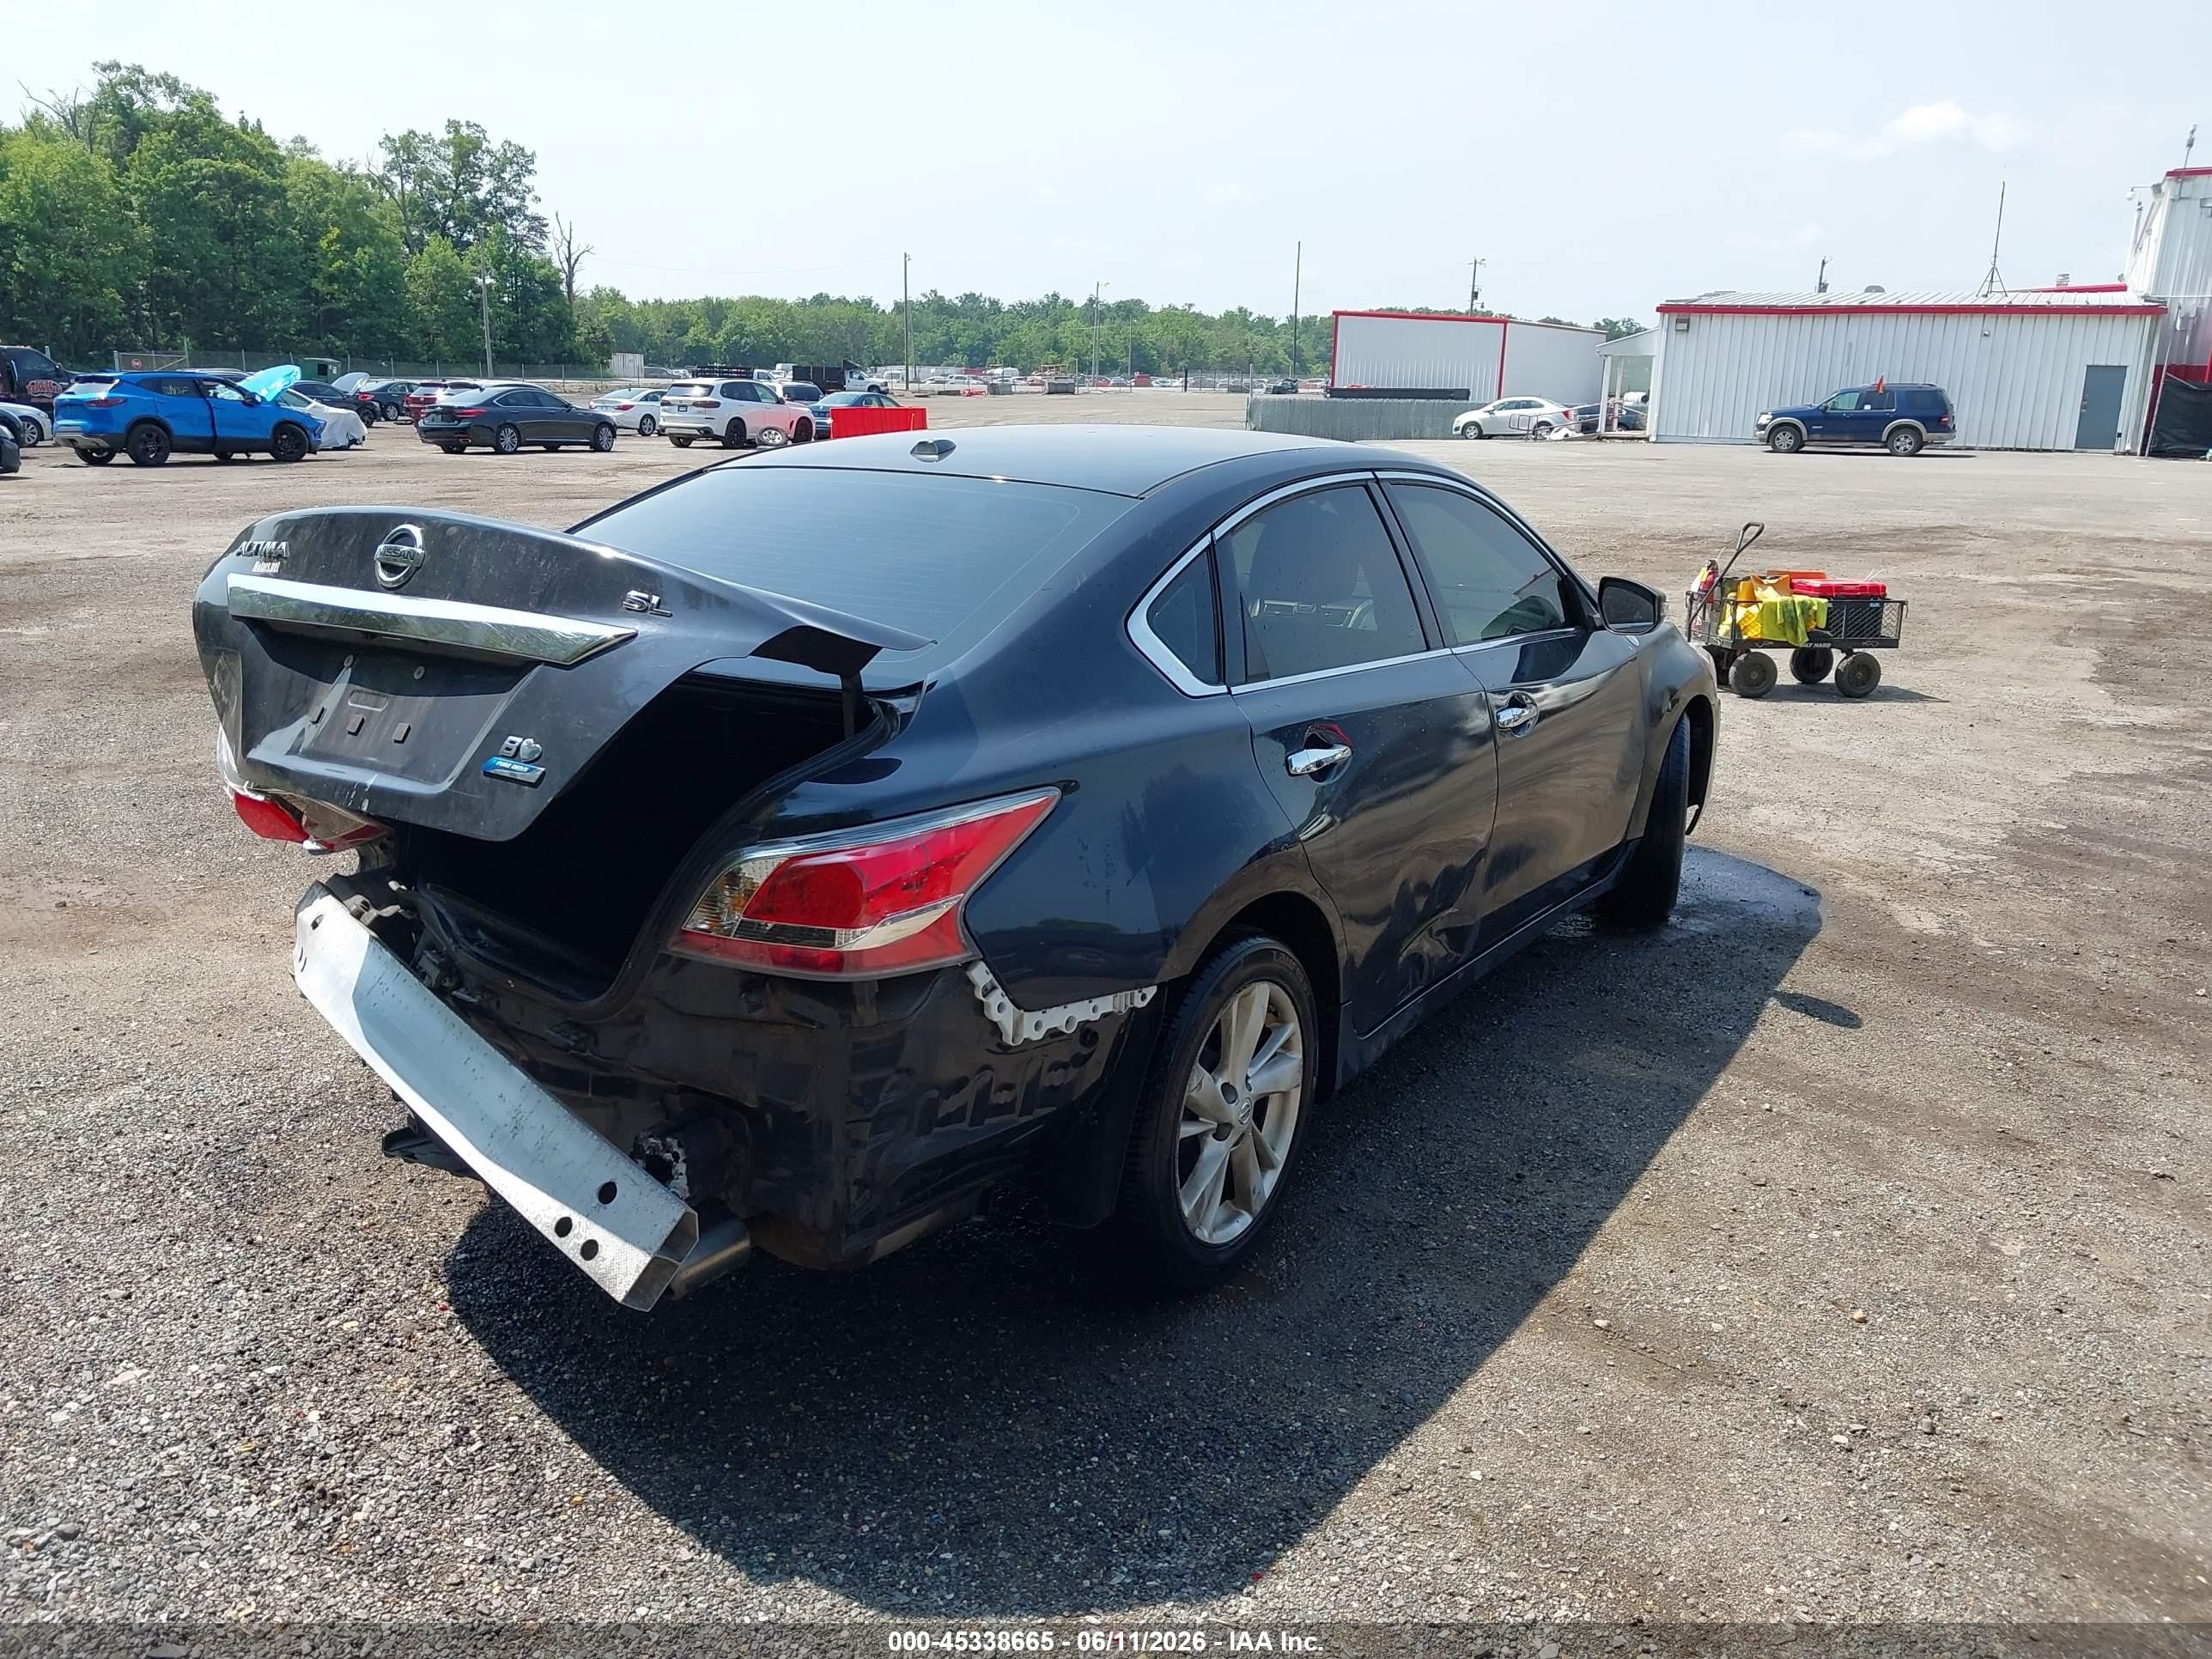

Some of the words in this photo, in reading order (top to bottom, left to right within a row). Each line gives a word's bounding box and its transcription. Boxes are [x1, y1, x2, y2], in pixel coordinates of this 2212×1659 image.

[27, 385, 62, 393] TOWING
[235, 540, 289, 557] ALTIMA
[377, 547, 416, 561] NISSAN
[623, 590, 673, 617] SL
[495, 760, 512, 769] PURE
[511, 763, 530, 772] DRIVE
